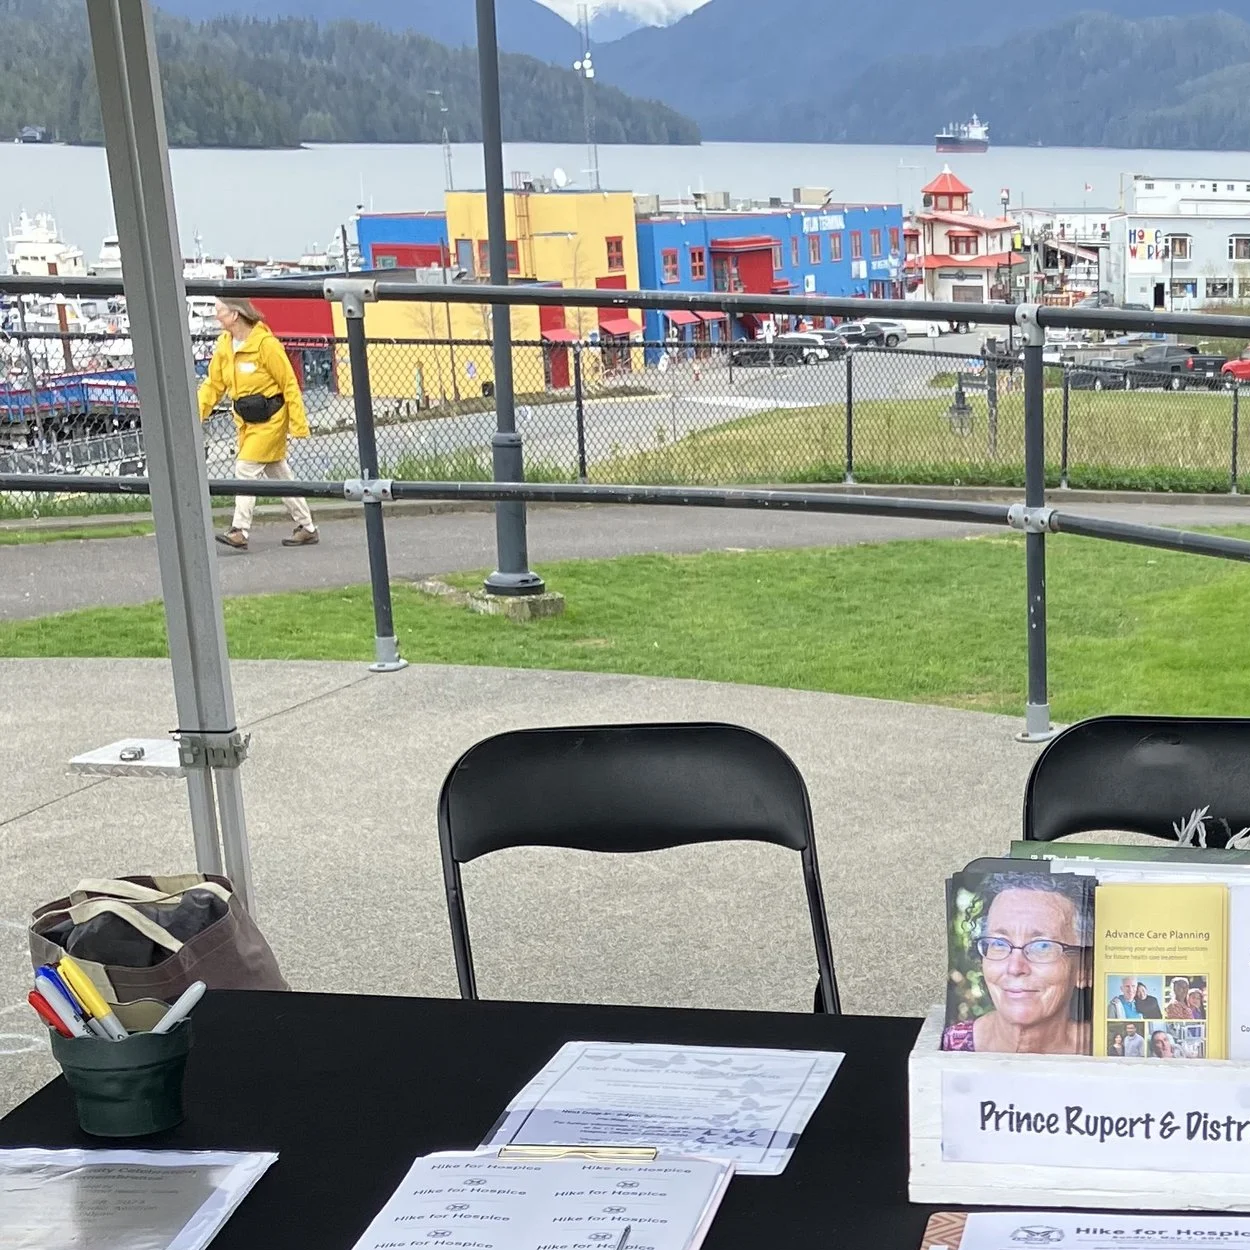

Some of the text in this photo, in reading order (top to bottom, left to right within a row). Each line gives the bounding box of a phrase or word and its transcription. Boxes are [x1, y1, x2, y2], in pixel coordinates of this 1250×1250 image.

[1105, 930, 1210, 941] Advance Care Planning
[980, 1101, 1059, 1133] Prince
[1065, 1106, 1155, 1143] Rupert
[1159, 1111, 1181, 1139] &
[413, 1188, 443, 1196] Hike
[470, 1187, 527, 1196] Hospice
[611, 1190, 667, 1198] Hospice
[394, 1214, 425, 1222] Hike
[453, 1213, 510, 1222] Hospice
[611, 1216, 668, 1224] Hospice
[1075, 1227, 1125, 1235] Hike
[434, 1240, 494, 1250] Hospice
[596, 1243, 655, 1250] Hopice
